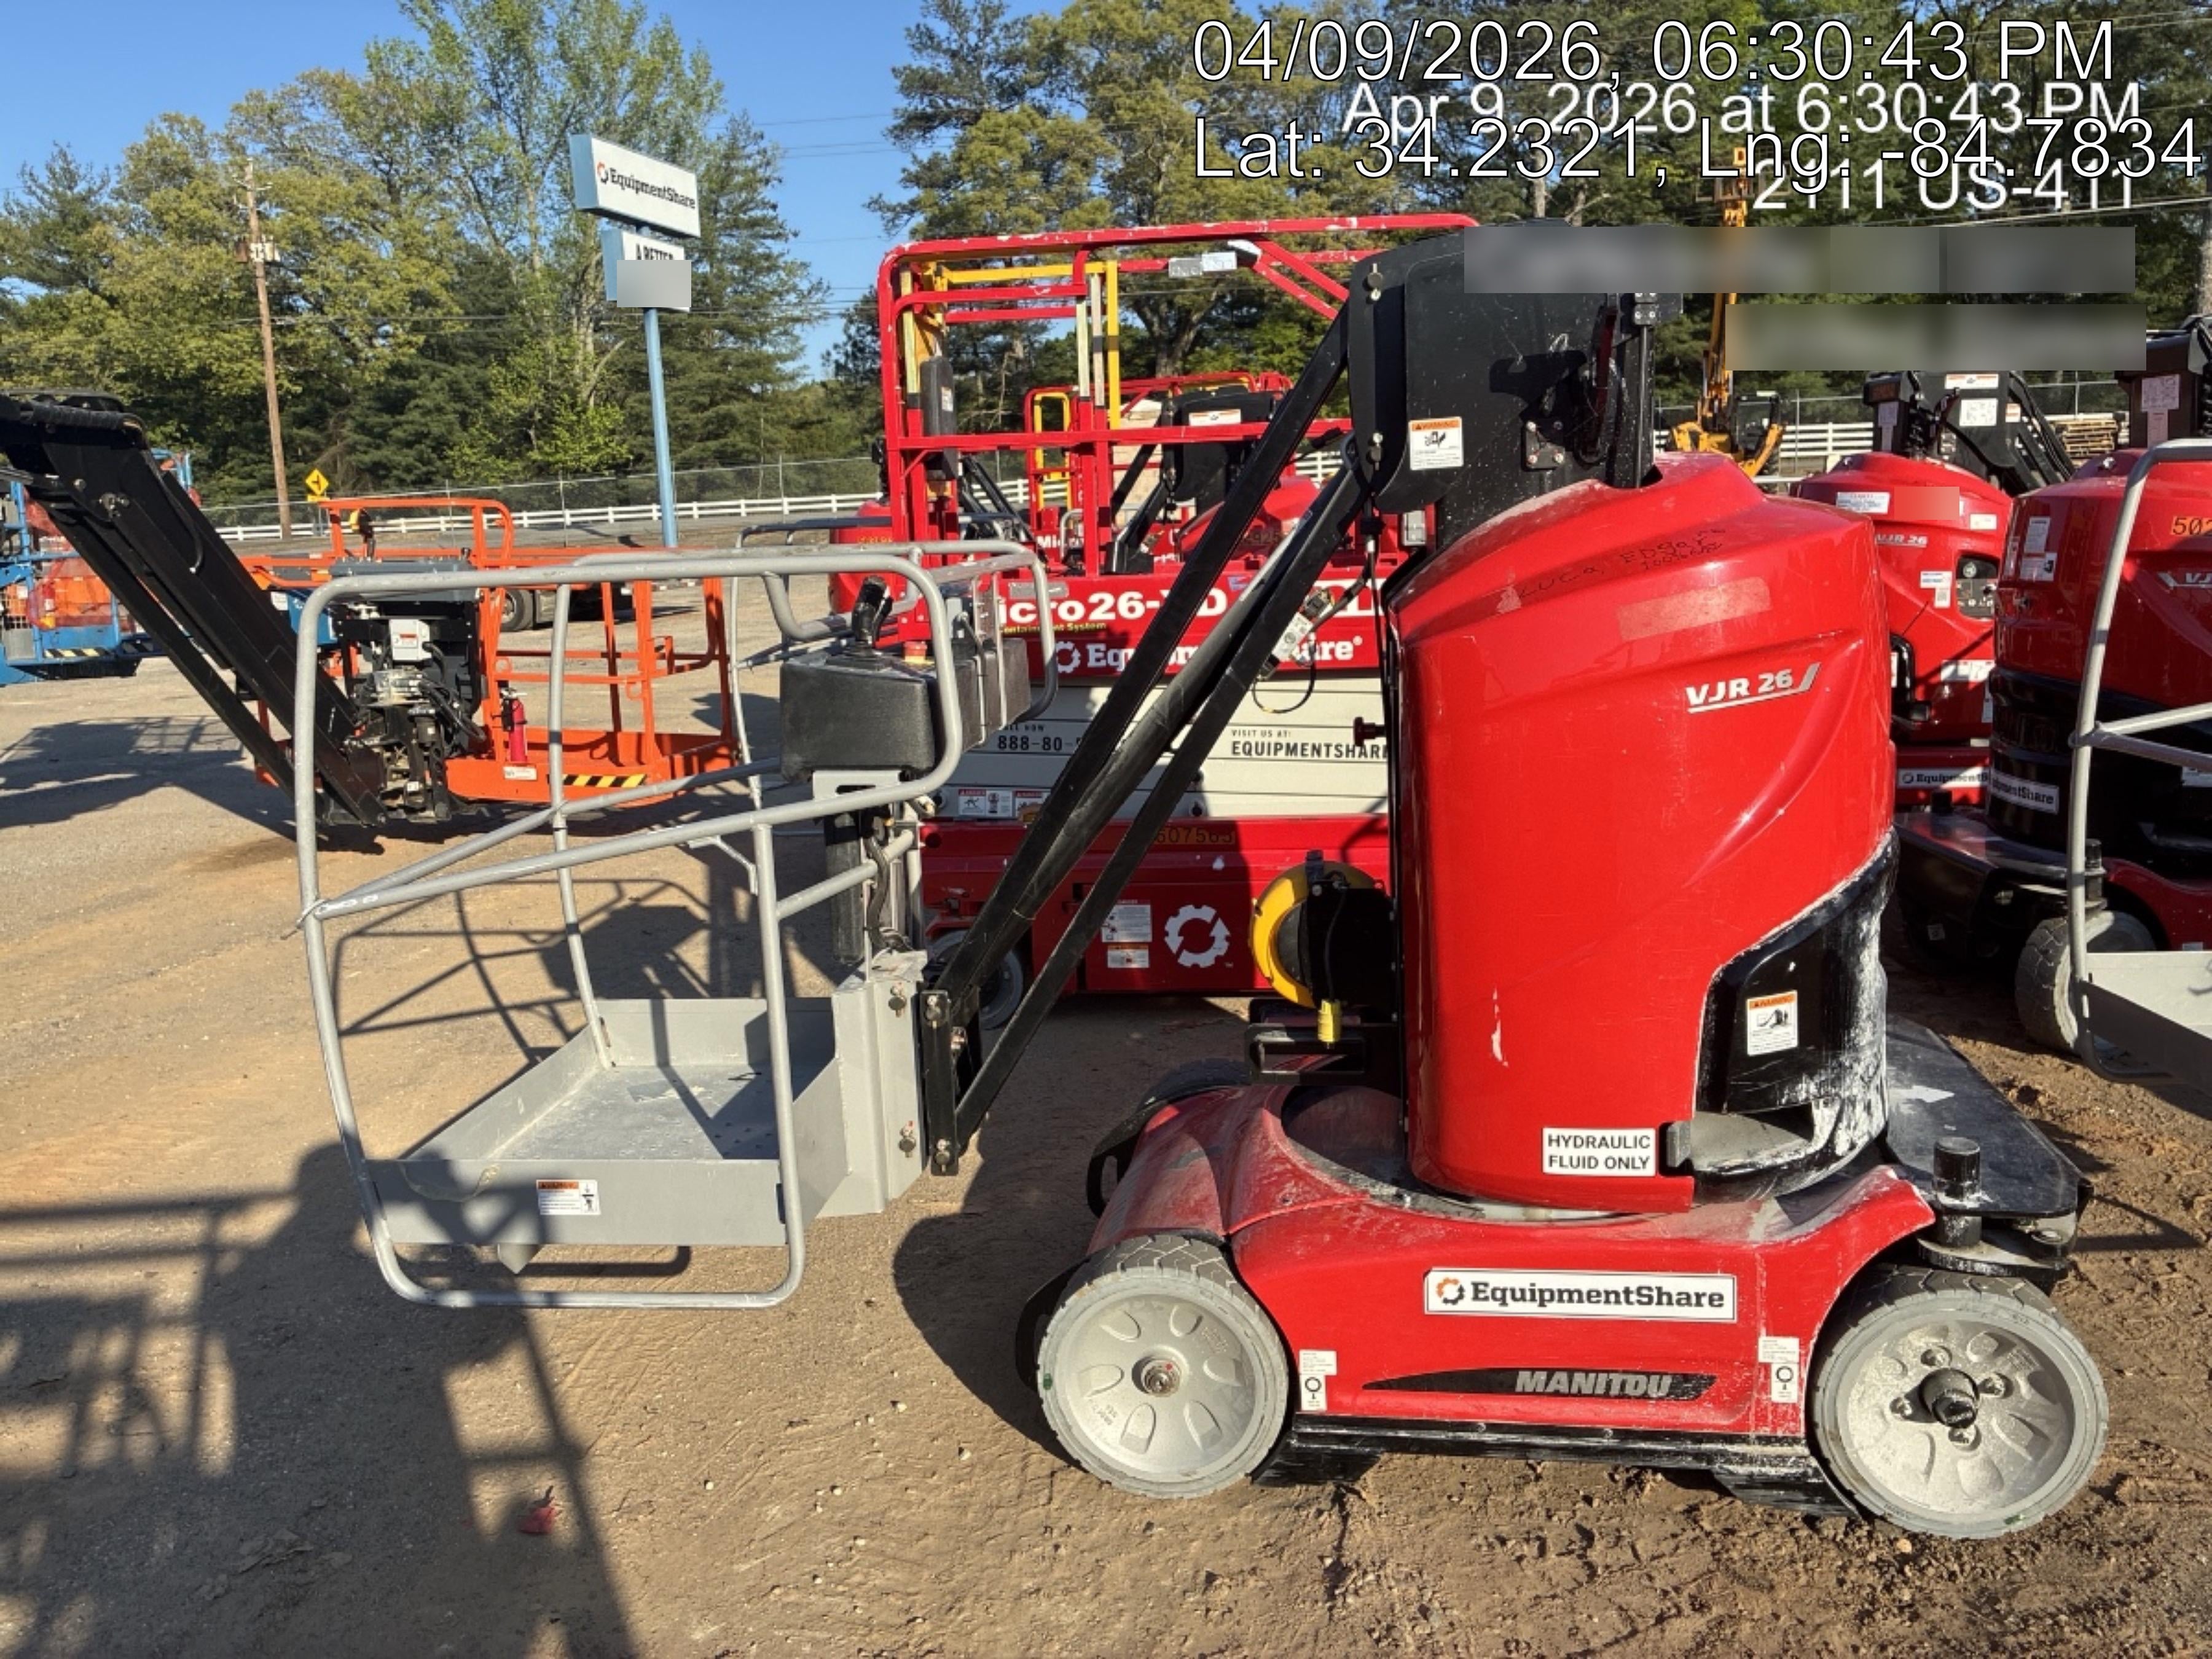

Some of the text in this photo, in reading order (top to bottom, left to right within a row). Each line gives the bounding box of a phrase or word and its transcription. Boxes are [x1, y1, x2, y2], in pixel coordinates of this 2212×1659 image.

[610, 167, 696, 210] EquipmentShare
[1685, 668, 1793, 706] VJR 26
[997, 735, 1080, 751] 888-80-
[1231, 729, 1257, 737] VISIT
[1260, 729, 1273, 738] US
[1547, 1134, 1650, 1149] HYDRAULIC
[1548, 1155, 1650, 1169] FLUID ONLY
[1471, 1281, 1724, 1308] EquipmentShare
[1515, 1371, 1673, 1396] MANITOU
